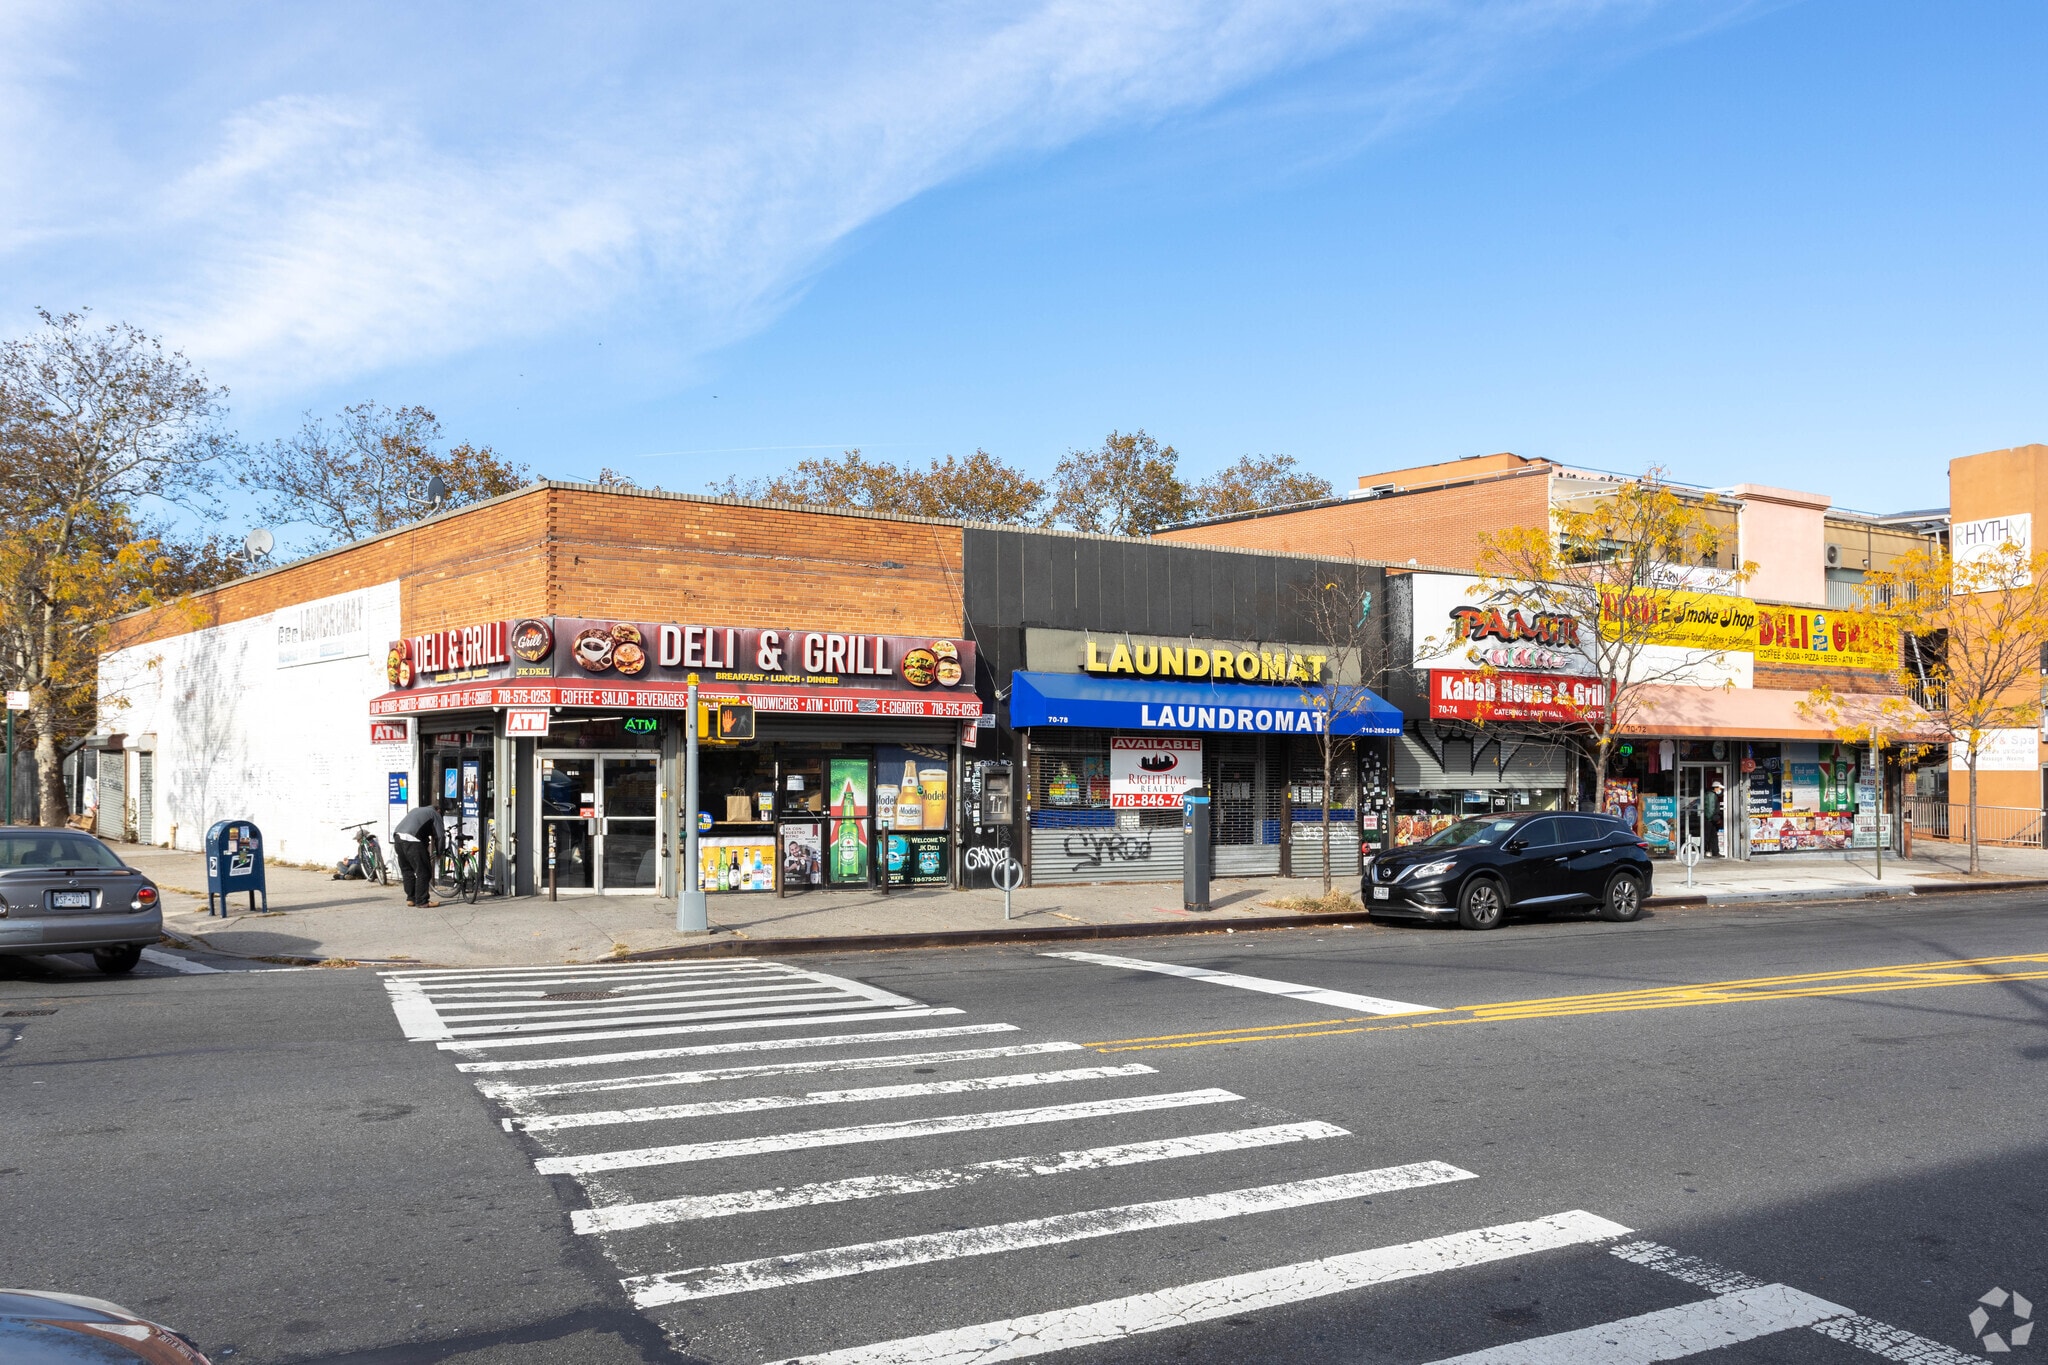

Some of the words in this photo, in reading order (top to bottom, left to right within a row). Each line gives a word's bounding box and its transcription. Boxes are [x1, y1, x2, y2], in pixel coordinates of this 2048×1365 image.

[1955, 519, 2027, 546] RHYTHM
[1673, 602, 1719, 625] Smoke
[1719, 605, 1755, 632] Shop
[1450, 605, 1582, 649] PAMIR
[1759, 610, 1809, 649] DELI
[415, 631, 444, 673] DELI
[447, 634, 460, 669] &
[463, 621, 505, 668] GRILL
[517, 633, 543, 648] Grill
[659, 625, 734, 669] DELI
[758, 630, 782, 672] &
[804, 633, 893, 675] GRILL
[1759, 650, 1781, 660] COFFEE
[1785, 652, 1800, 661] SODA
[1804, 653, 1820, 662] PIZZA
[1823, 654, 1838, 663] BEER
[1842, 655, 1853, 663] ATM
[1087, 641, 1327, 682] LAUNDROMAT
[516, 667, 528, 676] JK
[529, 667, 551, 676] DELI
[715, 672, 764, 683] BREAKFAST
[771, 675, 800, 684] LUNCH
[807, 676, 839, 685] DINNER
[498, 689, 551, 704] 718-575-0253
[1441, 676, 1496, 702] Kabab
[1501, 679, 1553, 705] House
[561, 690, 595, 705] COFFEE
[601, 692, 629, 706] SALAD
[636, 692, 685, 708] BEVERAGES
[747, 695, 799, 711] SANDWICHES
[806, 698, 823, 712] ATM
[829, 698, 853, 713] LOTTO
[881, 700, 924, 714] E-CIGARTES
[931, 702, 980, 717] 718-575-0253
[1438, 704, 1458, 714] 70-74
[1494, 708, 1523, 717] CATERING
[1530, 710, 1549, 718] PARTY
[509, 713, 546, 730] ATM
[624, 718, 657, 731] ATM
[1048, 716, 1069, 724] 70-78
[1141, 704, 1328, 733] LAUNDROMAT
[373, 725, 405, 740] ATM
[1114, 738, 1200, 751] AVAILABLE
[2010, 735, 2035, 747] Spa
[1620, 745, 1633, 754] ATM
[1140, 785, 1176, 793] REALTY
[1114, 794, 1184, 807] 718-846-76
